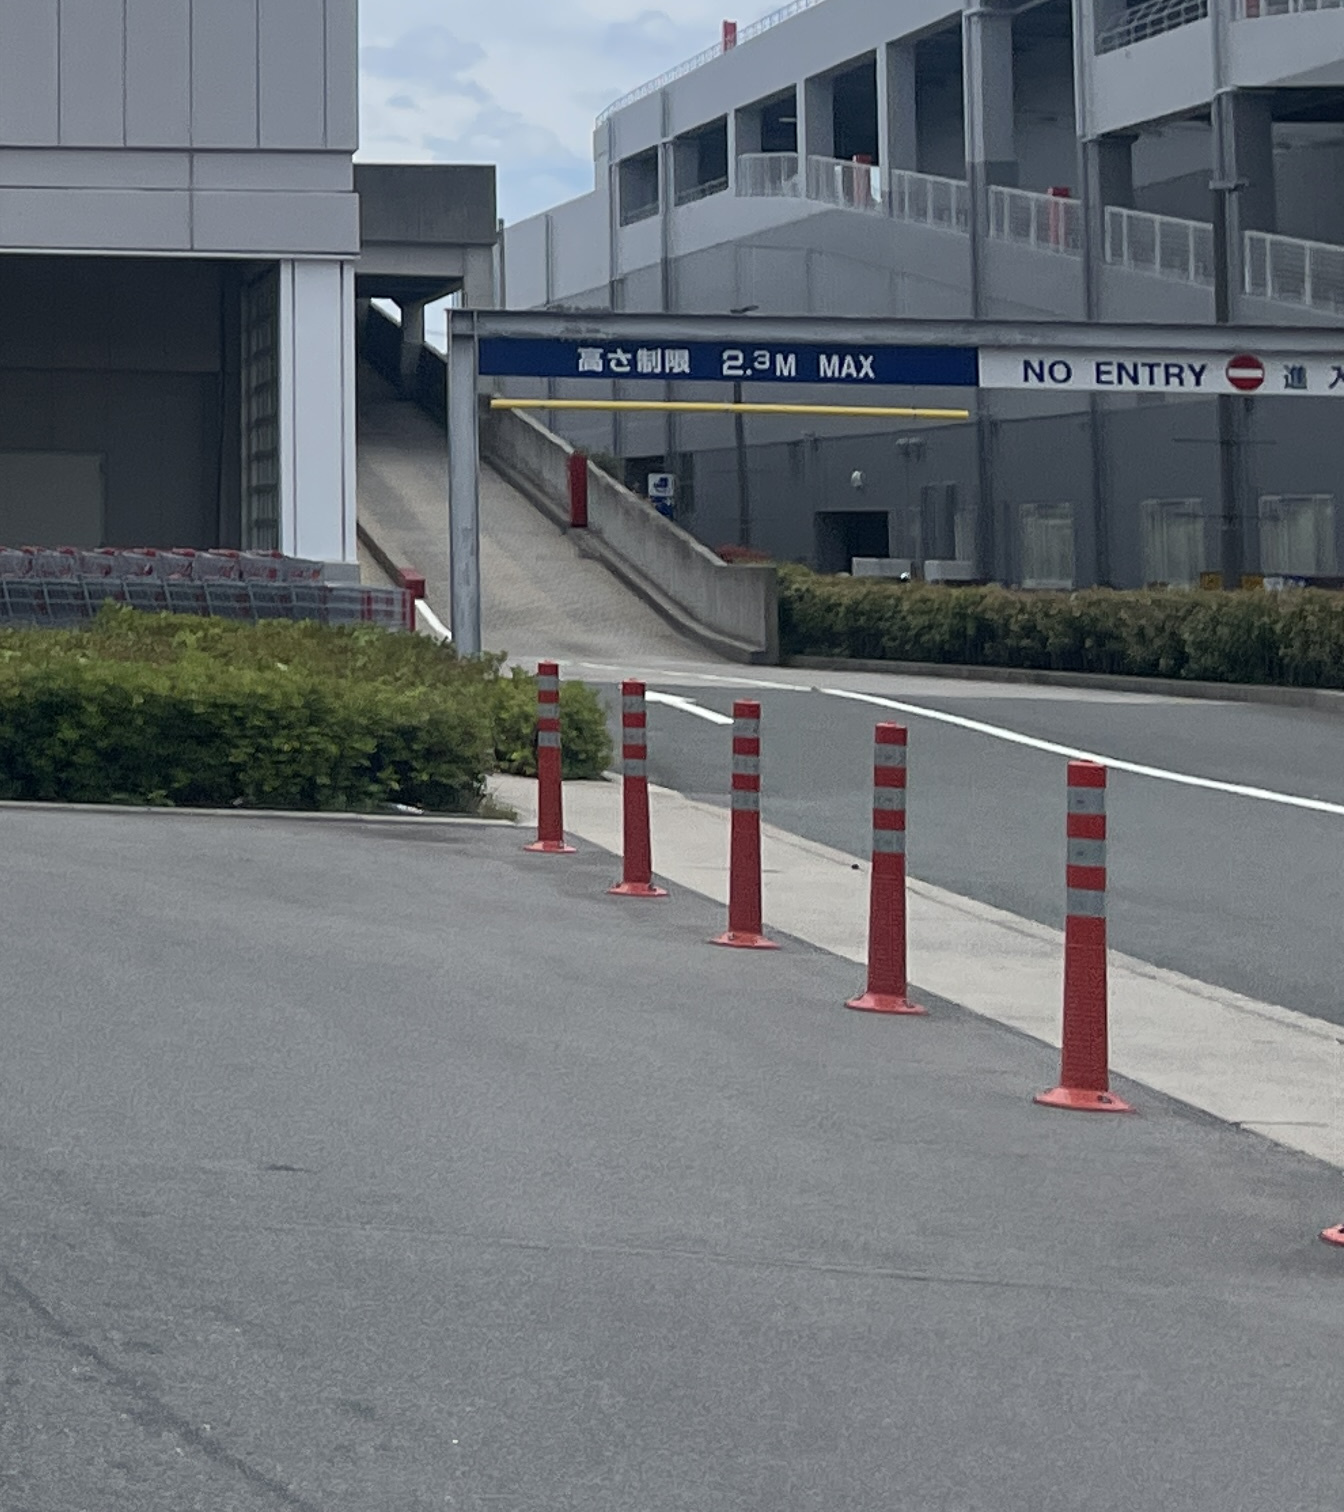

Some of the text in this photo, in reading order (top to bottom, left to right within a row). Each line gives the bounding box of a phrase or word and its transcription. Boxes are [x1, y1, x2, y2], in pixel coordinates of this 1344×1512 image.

[577, 347, 691, 374] 高さ制限
[819, 353, 876, 379] MAX
[1022, 359, 1073, 384] NO
[1095, 361, 1208, 387] ENTRY
